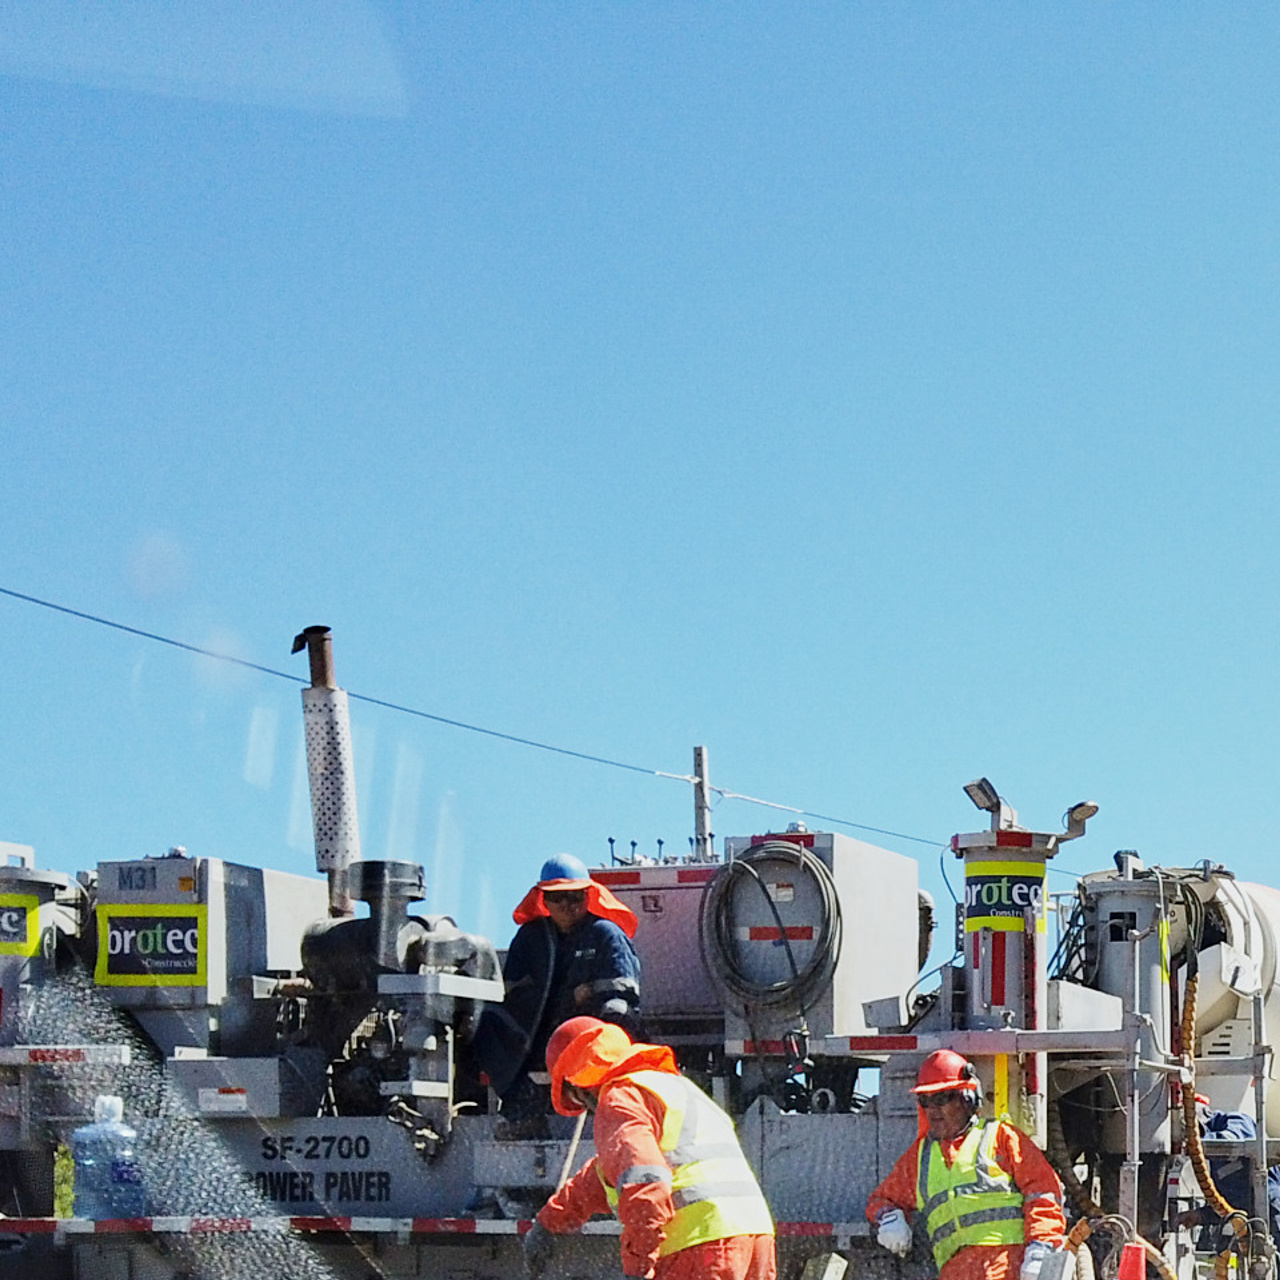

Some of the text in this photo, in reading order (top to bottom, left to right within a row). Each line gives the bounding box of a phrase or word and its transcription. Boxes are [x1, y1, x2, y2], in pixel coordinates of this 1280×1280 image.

[118, 867, 157, 890] M31
[261, 1136, 370, 1160] SF-2700
[325, 1172, 391, 1201] PAVER
